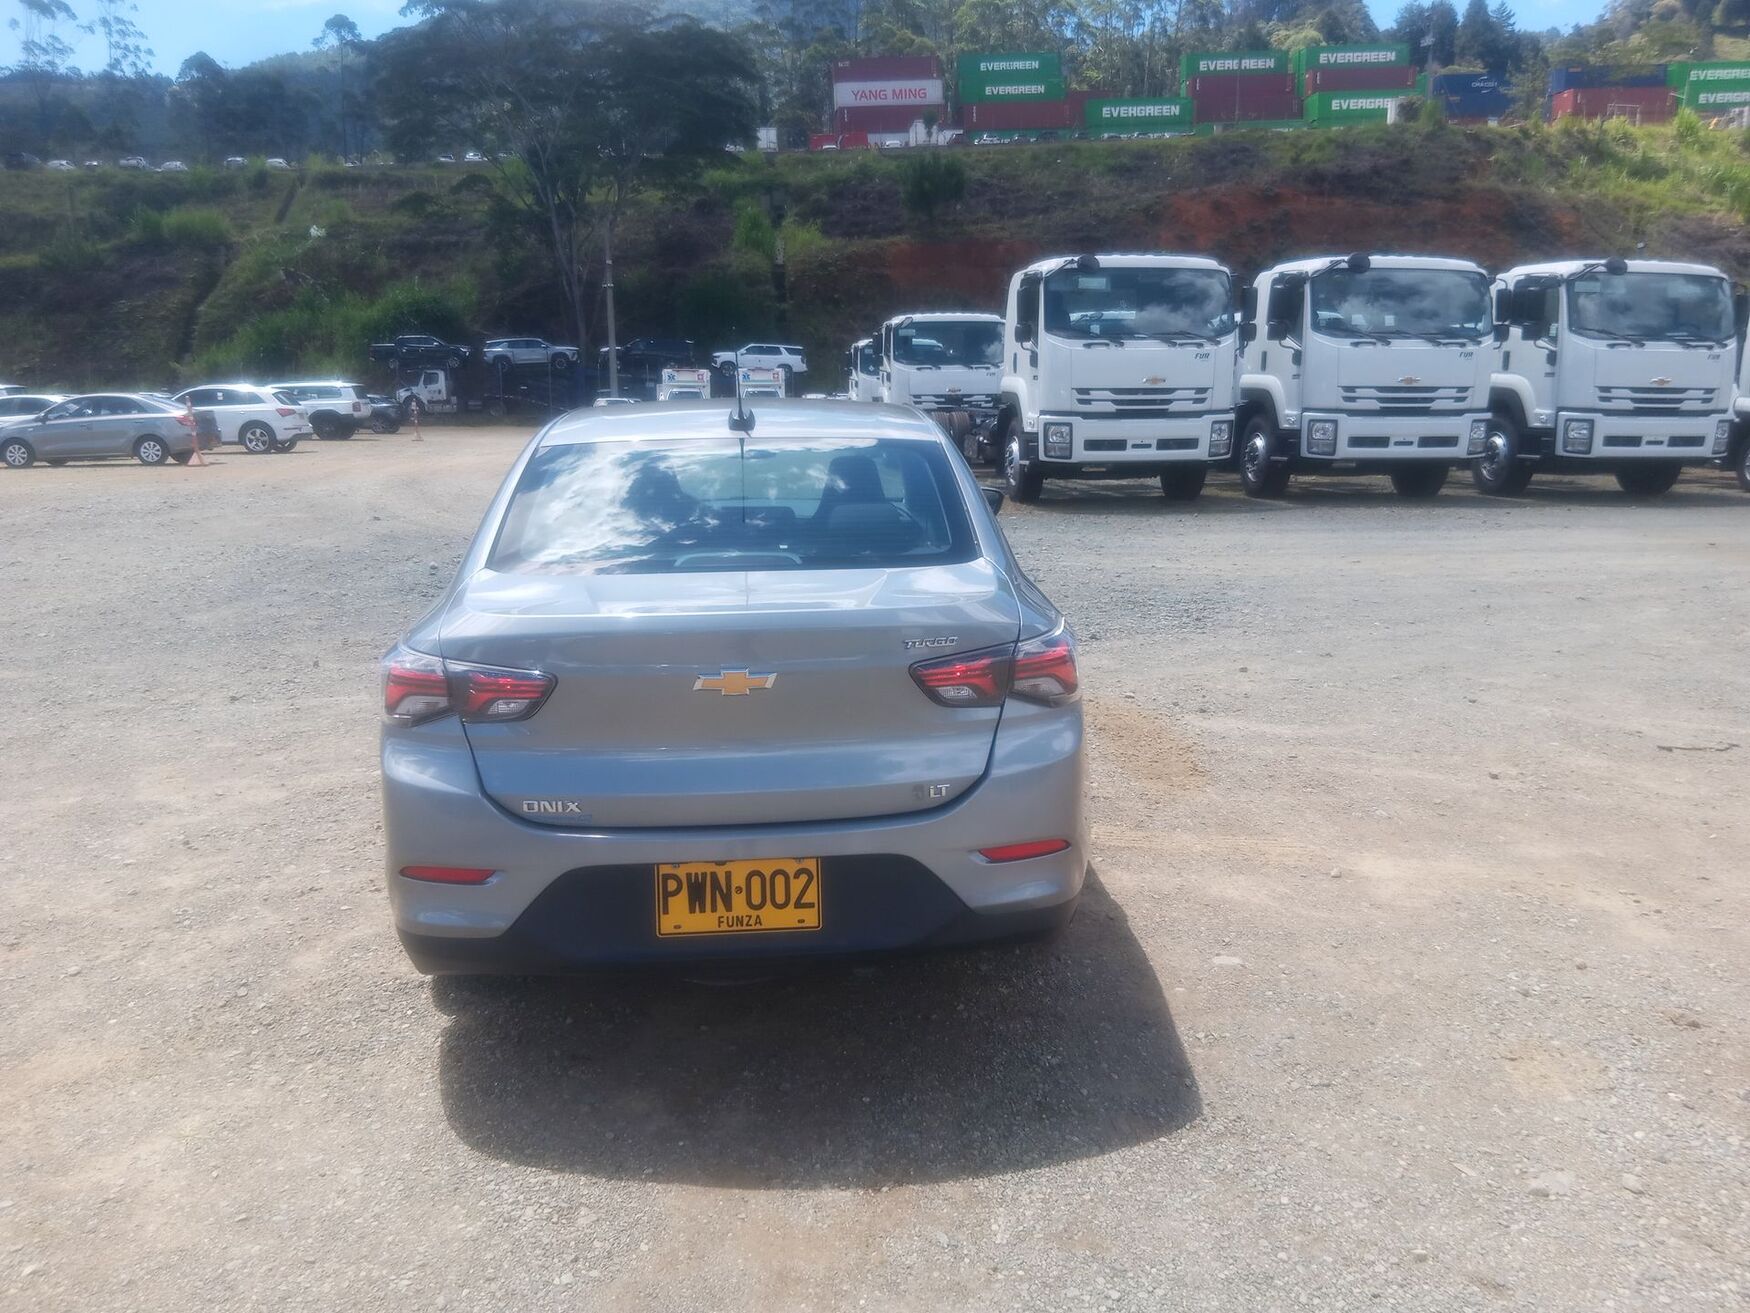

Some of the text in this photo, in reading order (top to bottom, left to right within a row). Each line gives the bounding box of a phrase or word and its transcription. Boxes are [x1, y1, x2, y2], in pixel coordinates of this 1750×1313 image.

[1319, 52, 1396, 64] EVERGREEN
[980, 61, 1039, 71] EVERGREEN
[851, 88, 928, 101] YANG MING
[985, 85, 1045, 96] EVERGREEN
[1102, 105, 1180, 118] EVERGREEN
[903, 636, 959, 649] TURBO
[929, 784, 951, 799] LT
[522, 800, 582, 813] ONIX
[717, 914, 763, 929] FUNZA
